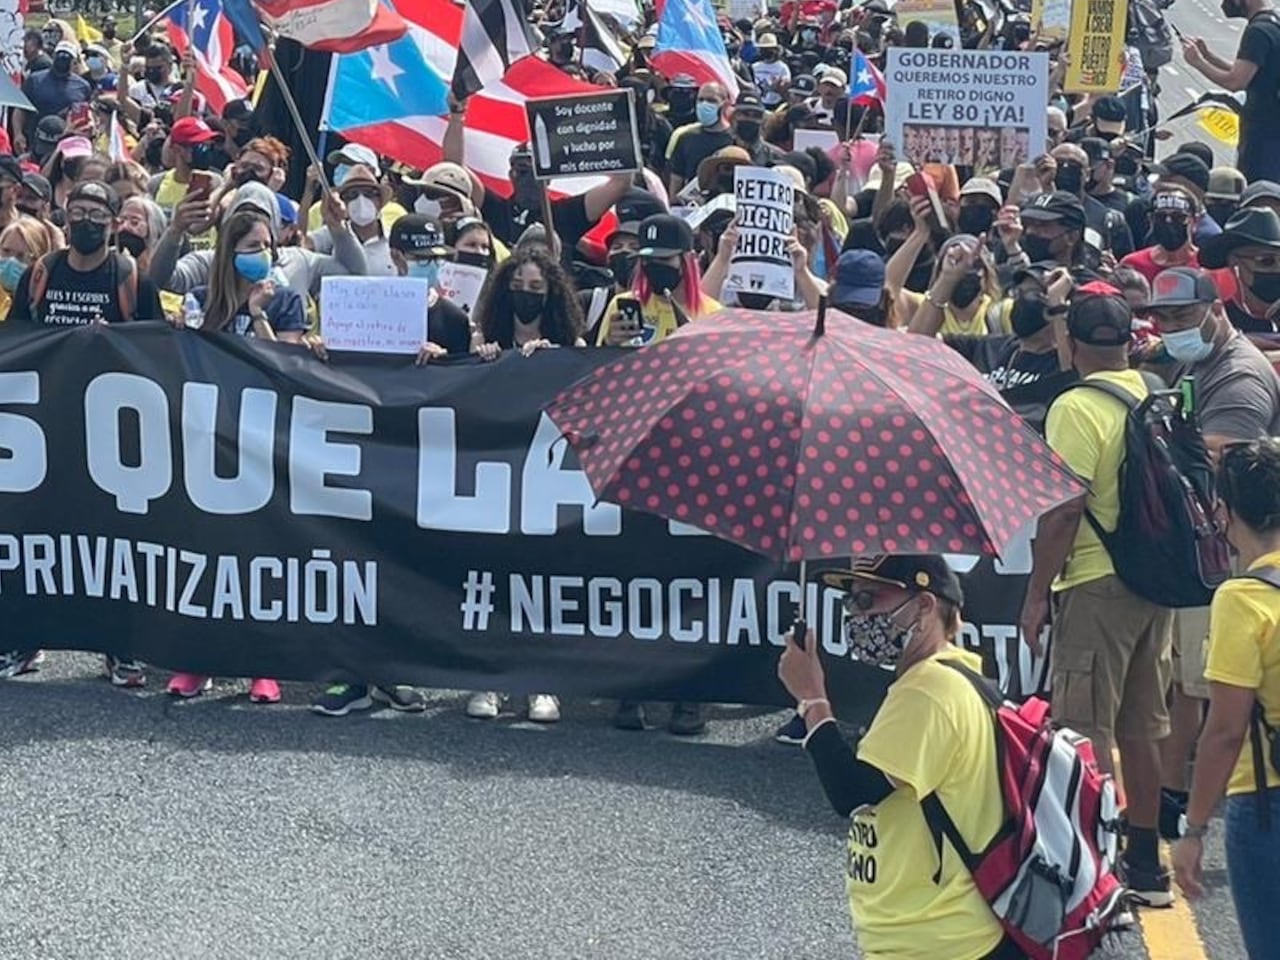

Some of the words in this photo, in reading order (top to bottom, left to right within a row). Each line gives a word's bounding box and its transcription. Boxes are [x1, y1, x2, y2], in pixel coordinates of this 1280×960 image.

[898, 52, 1030, 71] GOBERNADOR
[894, 71, 970, 85] QUEREMOS
[972, 74, 1037, 87] NUESTRO
[917, 88, 966, 101] RETIRO
[969, 90, 1015, 103] DIGNO
[554, 104, 572, 117] Soy
[574, 101, 613, 115] docente
[908, 102, 947, 120] LEY
[952, 105, 978, 122] 80
[984, 105, 1025, 127] ¡YA!
[556, 125, 574, 136] con
[575, 119, 617, 135] dignidad
[562, 145, 570, 156] y
[570, 141, 597, 153] lucho
[598, 140, 616, 152] por
[560, 161, 577, 172] mis
[578, 158, 624, 172] derechos.
[736, 179, 792, 206] RETIRO
[737, 204, 792, 235] DIGNO
[735, 234, 790, 259] AHORA
[83, 371, 374, 521] QUE
[417, 407, 621, 535] LA
